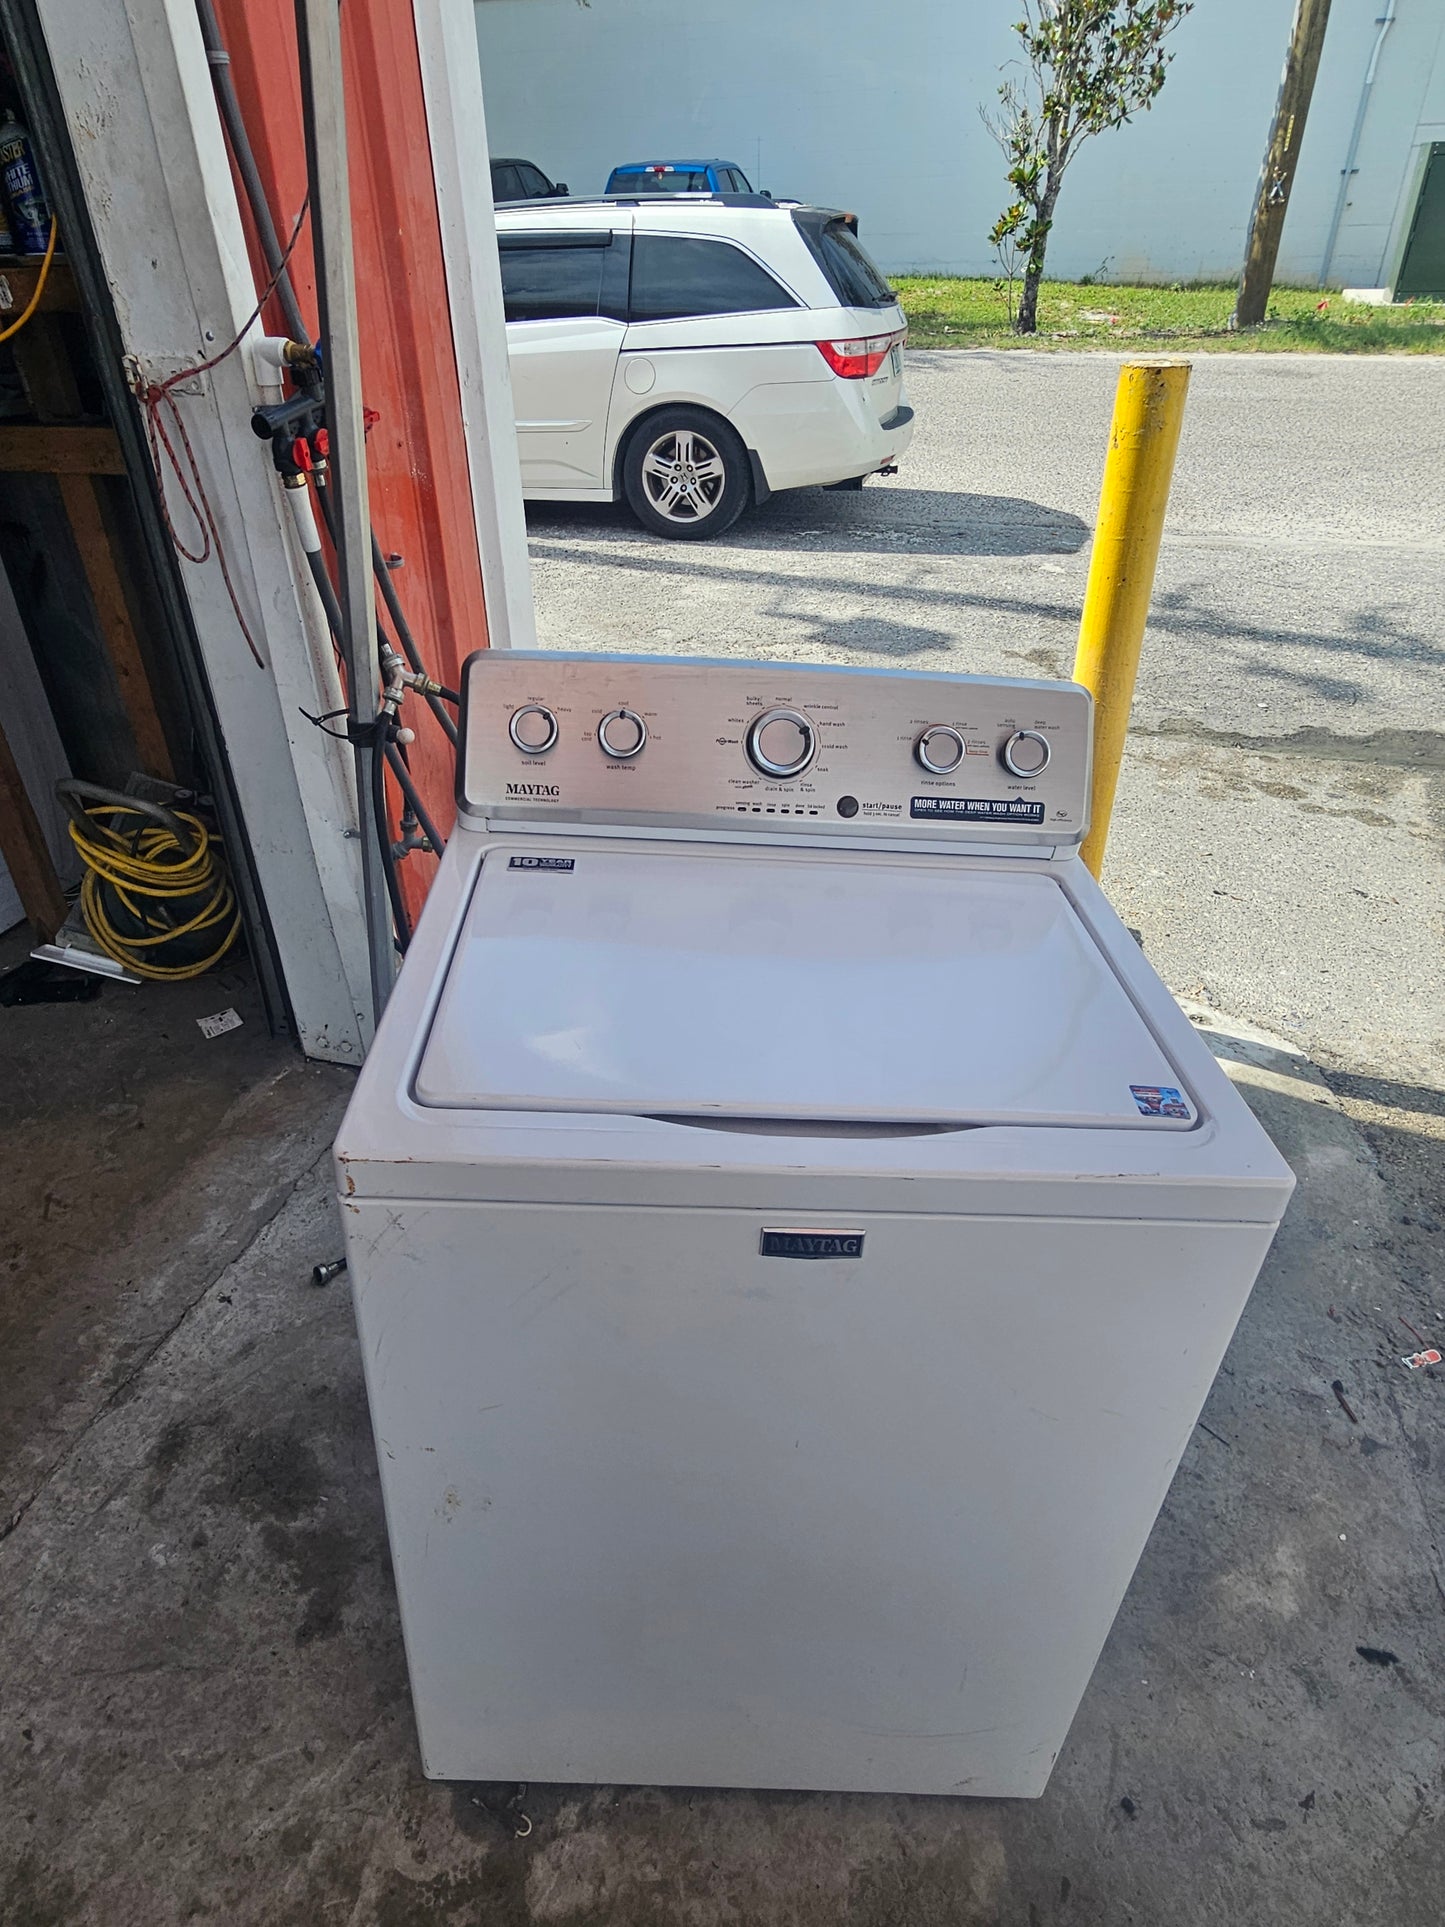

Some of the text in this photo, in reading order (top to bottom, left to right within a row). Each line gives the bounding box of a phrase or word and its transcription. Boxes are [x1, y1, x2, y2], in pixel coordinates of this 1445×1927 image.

[505, 783, 560, 796] MAYTAG
[862, 802, 902, 811] start/pause
[914, 799, 1041, 814] MORE WATER WHEN YOU WANT IT
[513, 858, 539, 866] 10
[769, 1237, 858, 1253] MAYTAG
